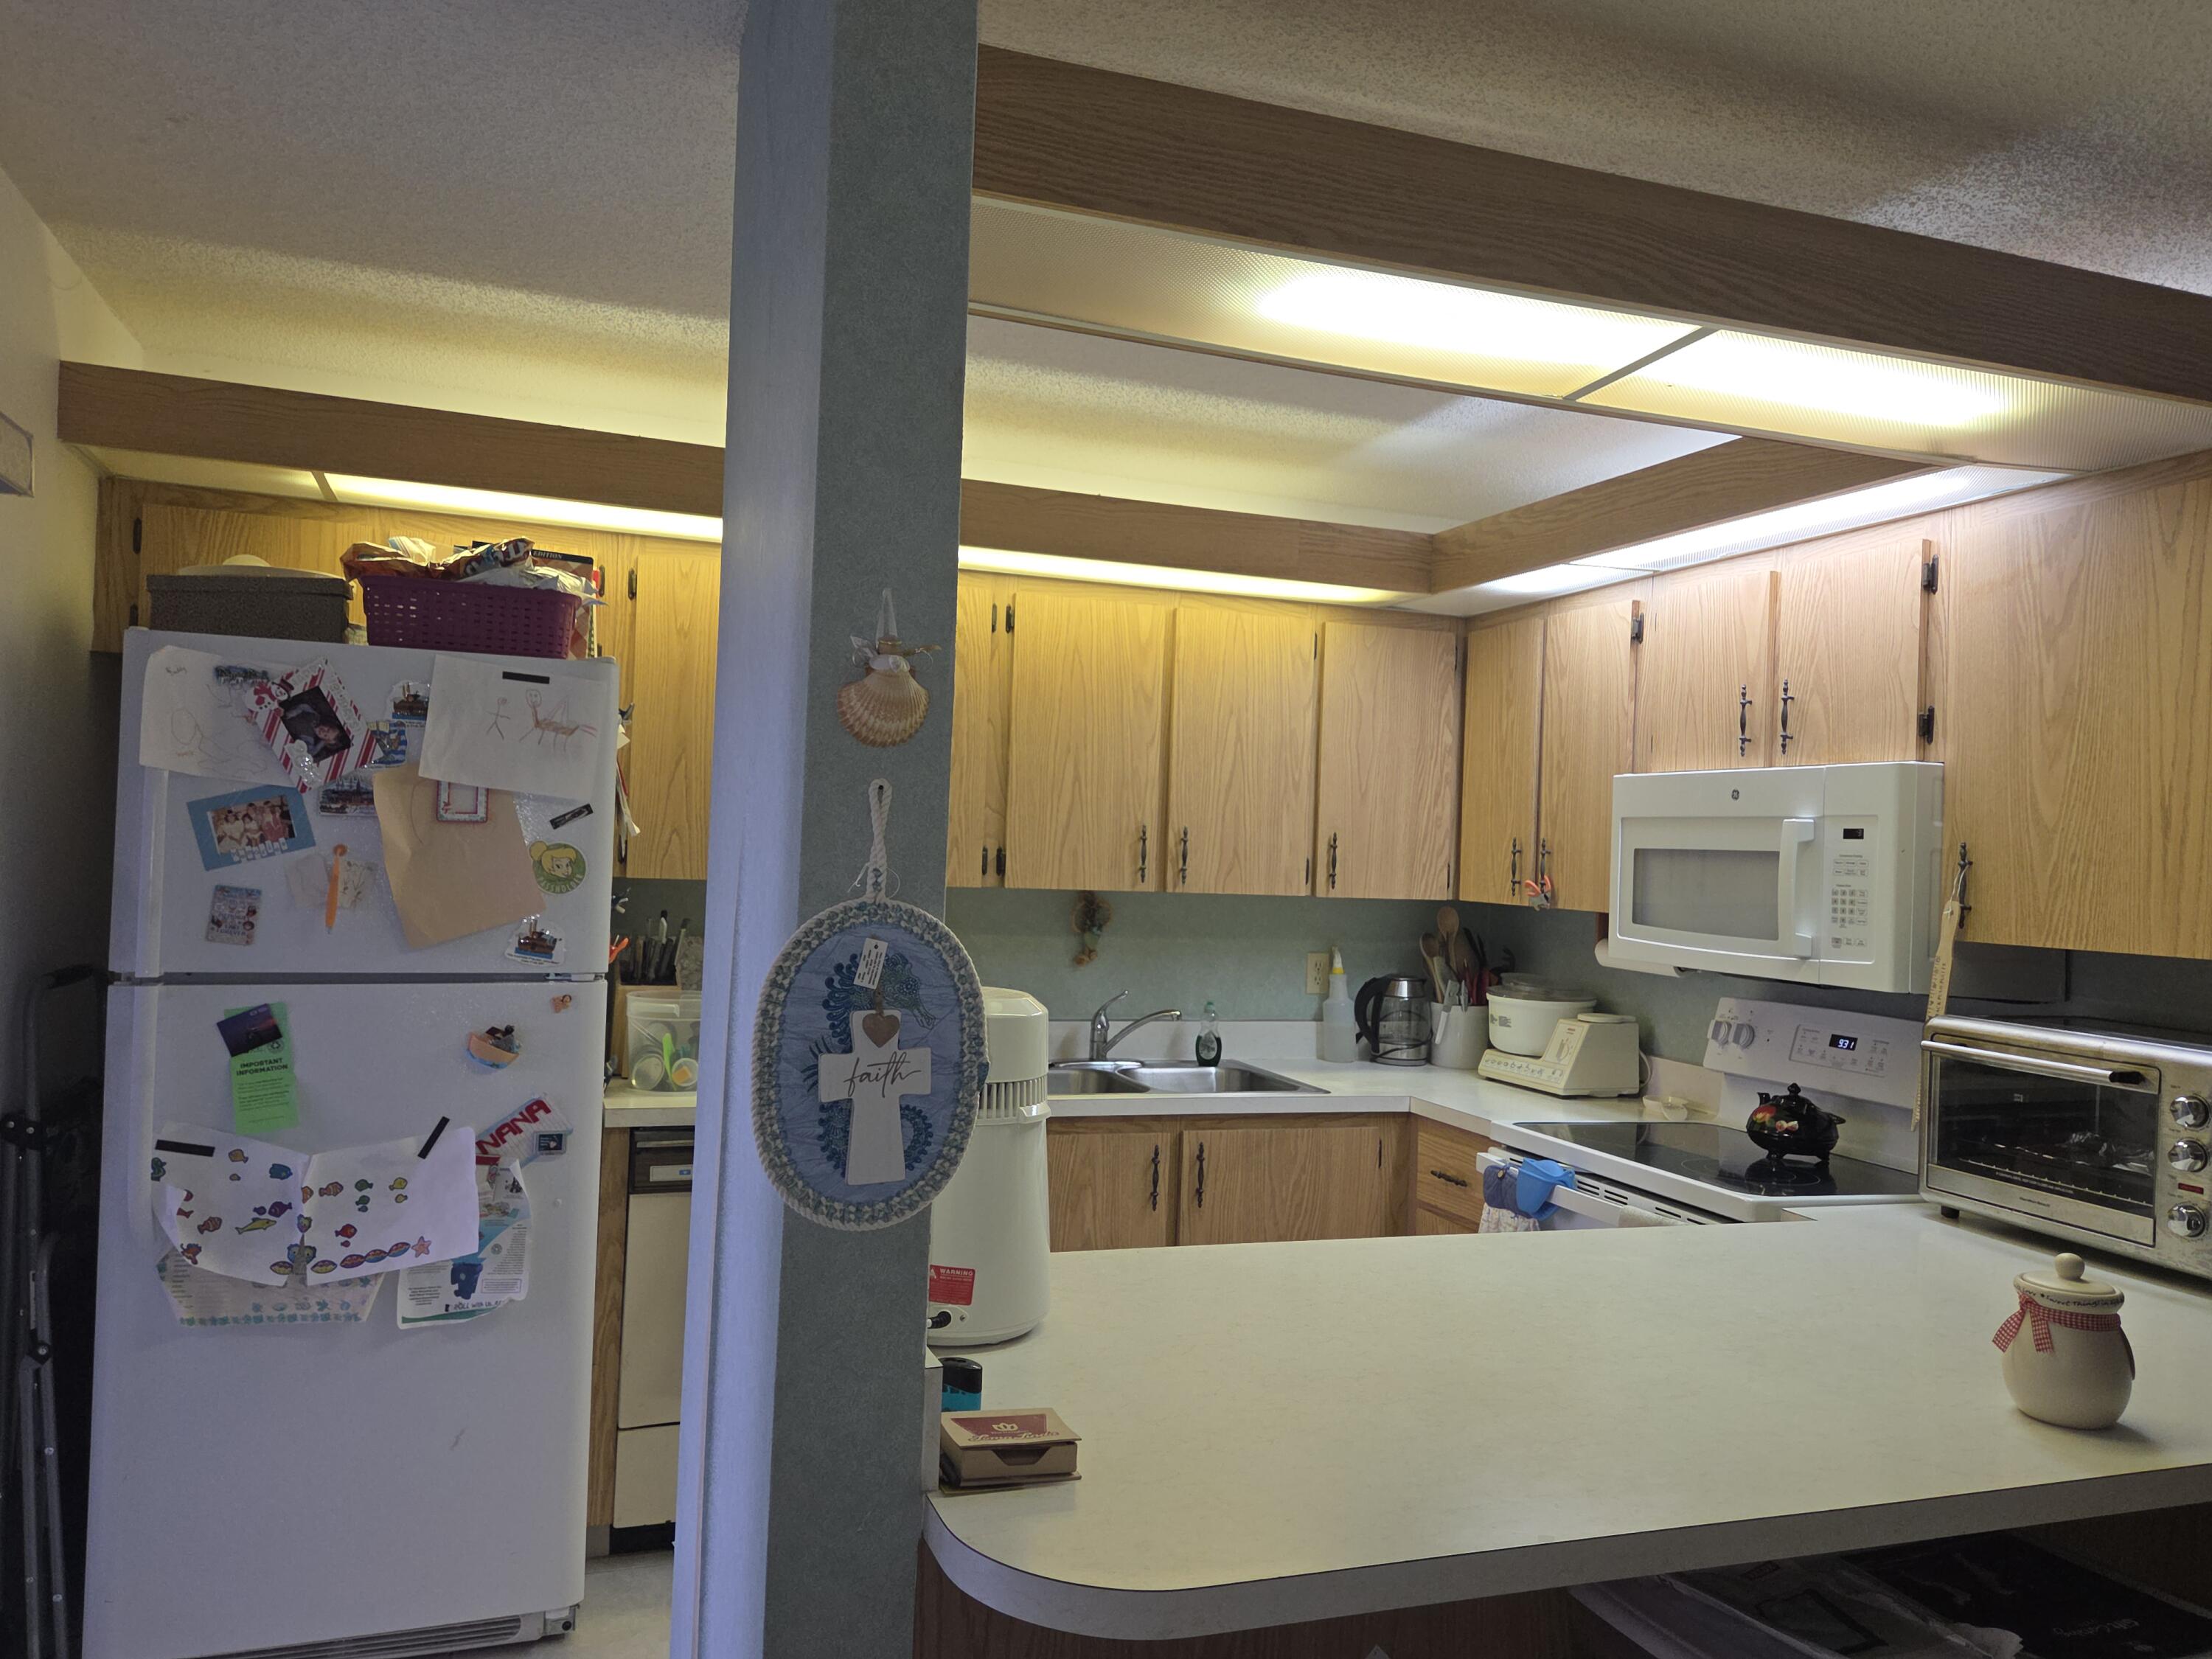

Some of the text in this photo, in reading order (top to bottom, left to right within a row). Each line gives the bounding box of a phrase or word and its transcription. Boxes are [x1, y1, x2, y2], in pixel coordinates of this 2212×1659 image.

[533, 549, 563, 560] EDITION
[240, 1057, 283, 1068] IMPORTANT
[236, 1064, 288, 1077] INFORMATION
[843, 1051, 922, 1099] faith
[476, 1099, 552, 1155] NANA
[939, 1267, 973, 1276] WARNING
